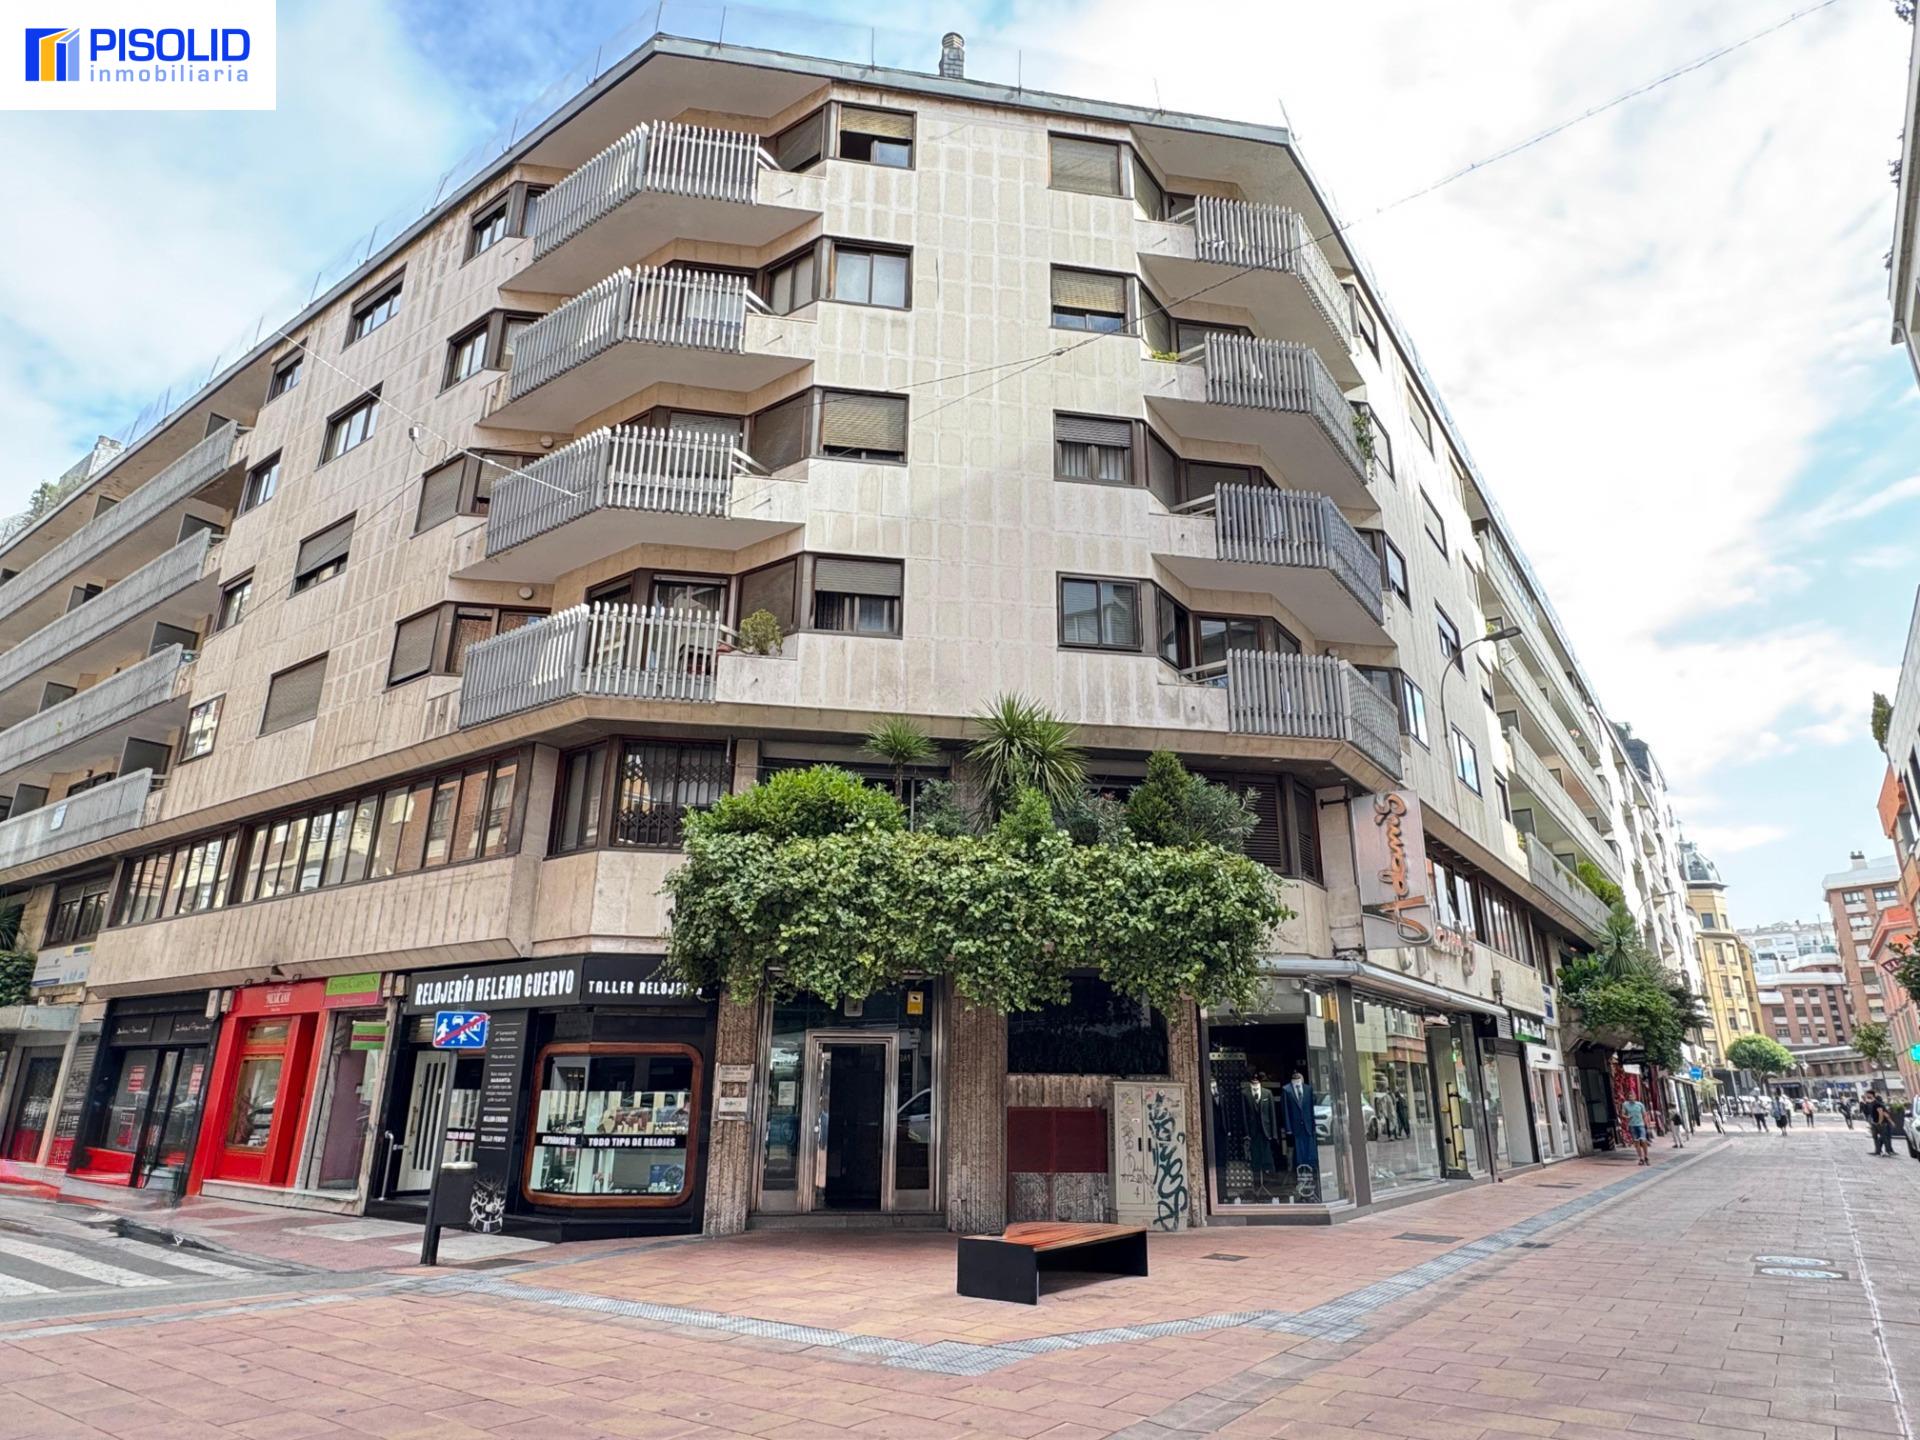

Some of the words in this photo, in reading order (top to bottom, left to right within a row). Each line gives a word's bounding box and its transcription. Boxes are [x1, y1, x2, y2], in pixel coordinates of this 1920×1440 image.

[414, 974, 475, 1006] RELOJERÍA
[475, 974, 522, 1001] HELENA
[524, 969, 575, 998] CUERVO
[588, 980, 634, 994] TALLER
[588, 1137, 612, 1147] TODO
[612, 1137, 630, 1147] TIPO
[631, 1137, 642, 1147] DE
